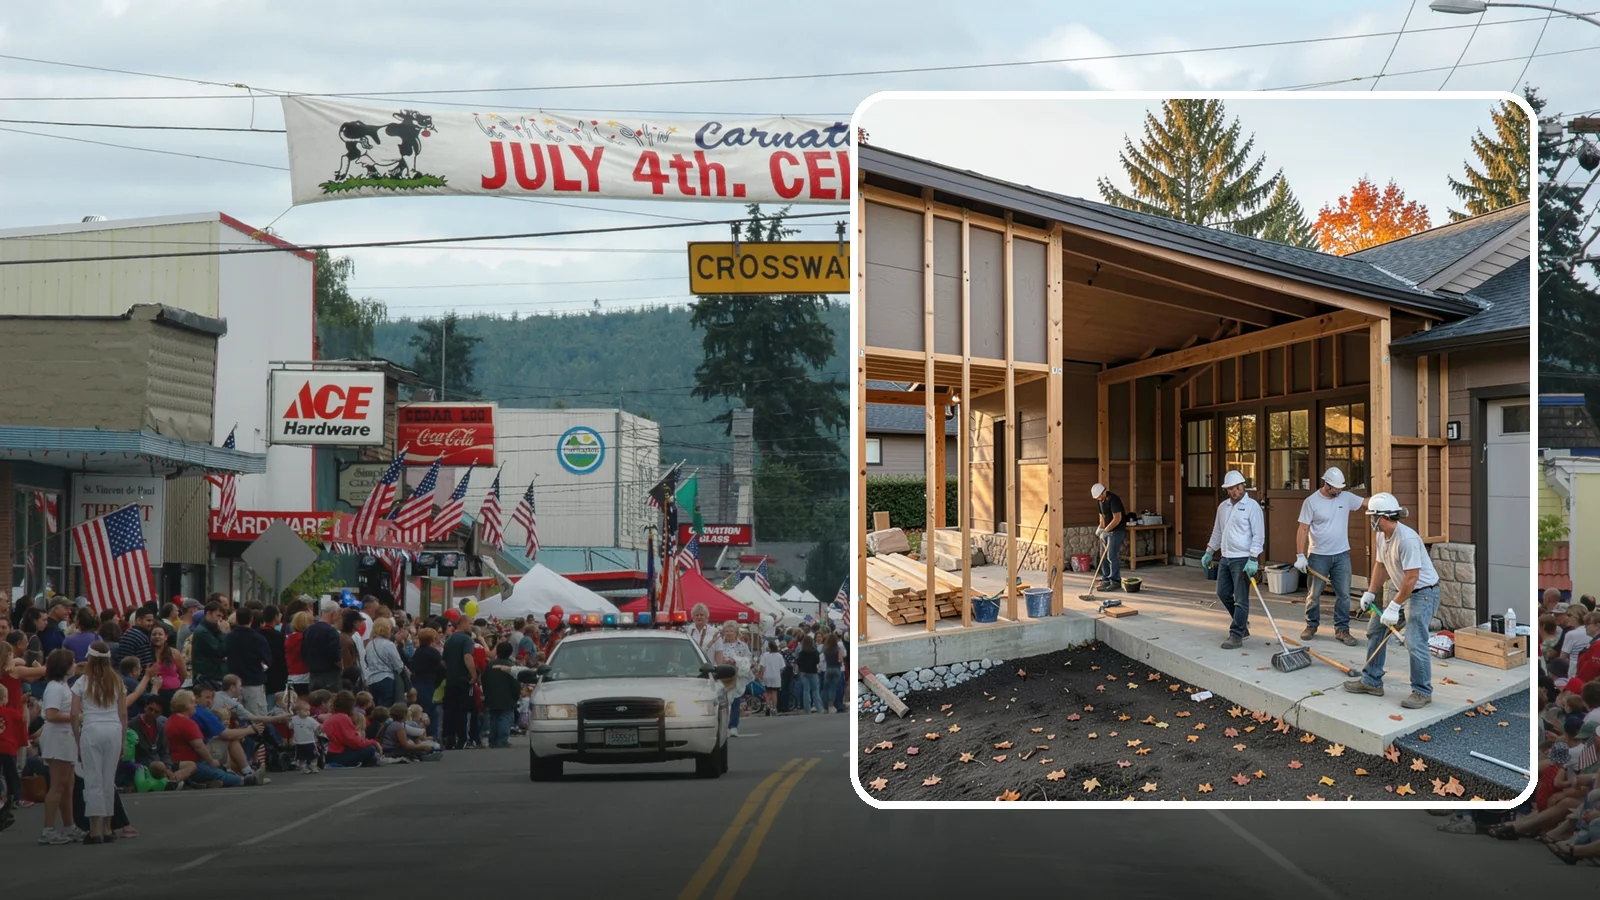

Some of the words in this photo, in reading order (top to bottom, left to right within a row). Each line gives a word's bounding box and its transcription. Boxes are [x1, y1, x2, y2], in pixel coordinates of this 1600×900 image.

[481, 140, 605, 192] JULY
[632, 150, 747, 198] 4th.
[696, 254, 850, 280] CROSSWA
[283, 380, 373, 420] ACE
[405, 409, 452, 421] CEDAR
[283, 421, 371, 437] Hardware
[416, 428, 477, 447] Coca-Cola
[353, 466, 384, 480] Simpl
[95, 485, 124, 495] Vincent
[126, 486, 136, 495] de
[137, 486, 155, 495] Paul
[688, 526, 741, 535] CRNATION
[699, 535, 730, 543] GLASS
